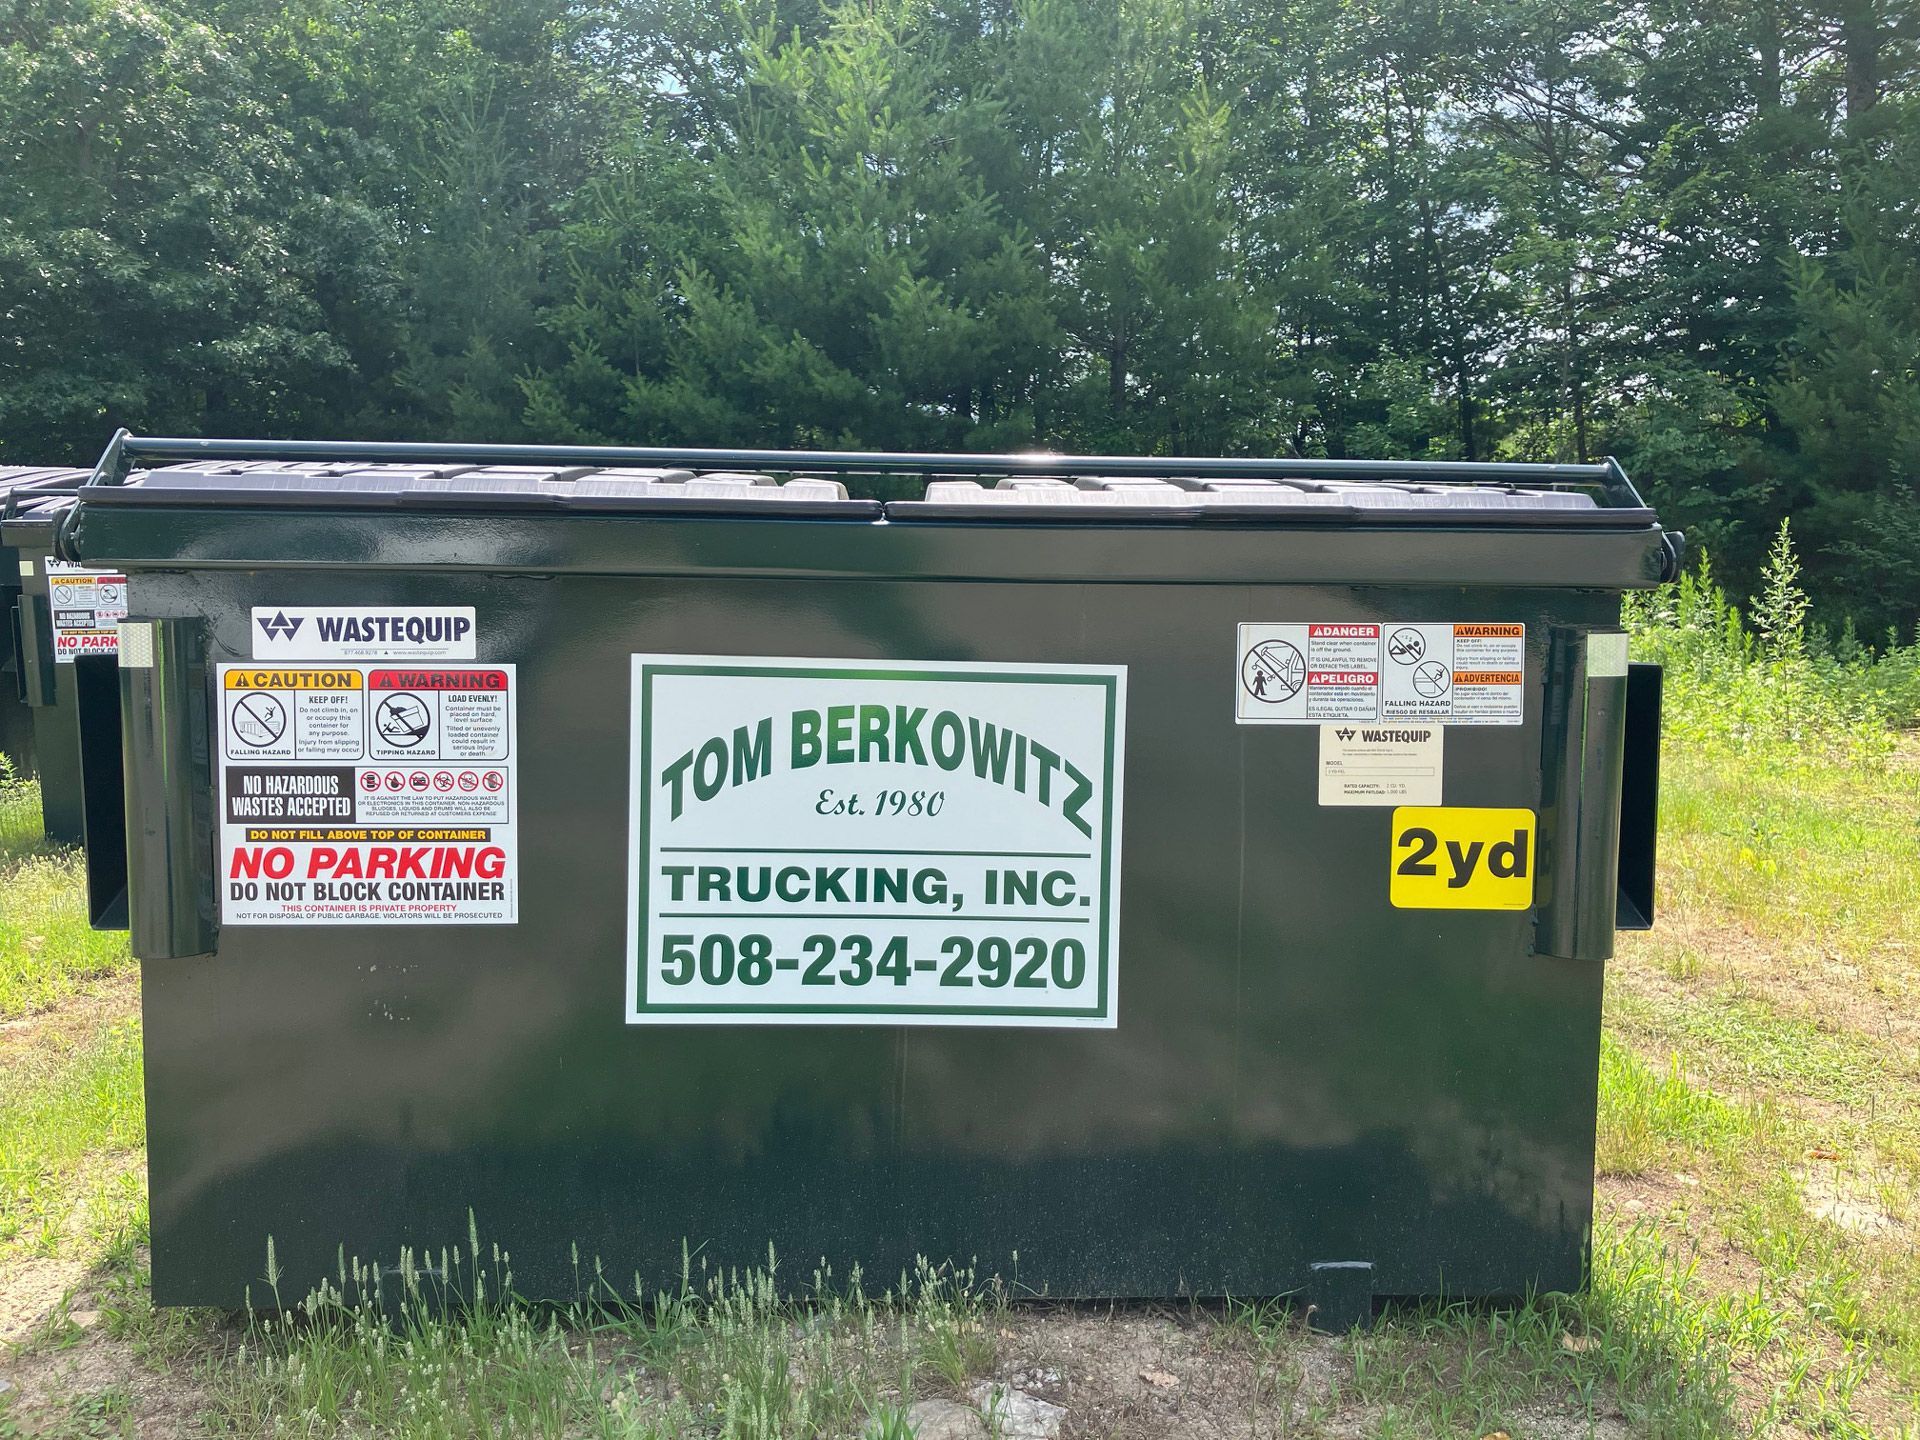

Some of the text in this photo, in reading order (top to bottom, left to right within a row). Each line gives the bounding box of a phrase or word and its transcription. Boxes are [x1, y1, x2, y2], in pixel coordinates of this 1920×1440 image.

[316, 616, 471, 644] WASTEQUIP
[1324, 627, 1374, 637] DANGER
[1464, 627, 1519, 635] WARNING
[81, 637, 118, 647] PARK
[254, 673, 352, 687] CAUTION
[398, 674, 499, 688] WARNING
[1320, 674, 1374, 684] PELIGRO
[1362, 730, 1431, 743] WASTEQUIP
[662, 704, 1093, 840] TOM BERKOWITZ
[244, 776, 338, 794] NO HAZARDOUS
[232, 798, 350, 816] WASTES ACCEPTED
[816, 789, 945, 816] Est. 1980
[251, 831, 485, 839] DO NOT FILL ABOVE TOP OF CONTAINER
[230, 847, 506, 879] NO PARKING
[1397, 827, 1528, 888] 2yd
[230, 882, 258, 901] DO
[266, 882, 306, 901] NOT
[314, 882, 382, 901] BLOCK
[388, 882, 504, 901] CONTAINER
[662, 866, 1091, 912] TRUCKING, INC.
[662, 934, 1086, 989] 508-234-2920
